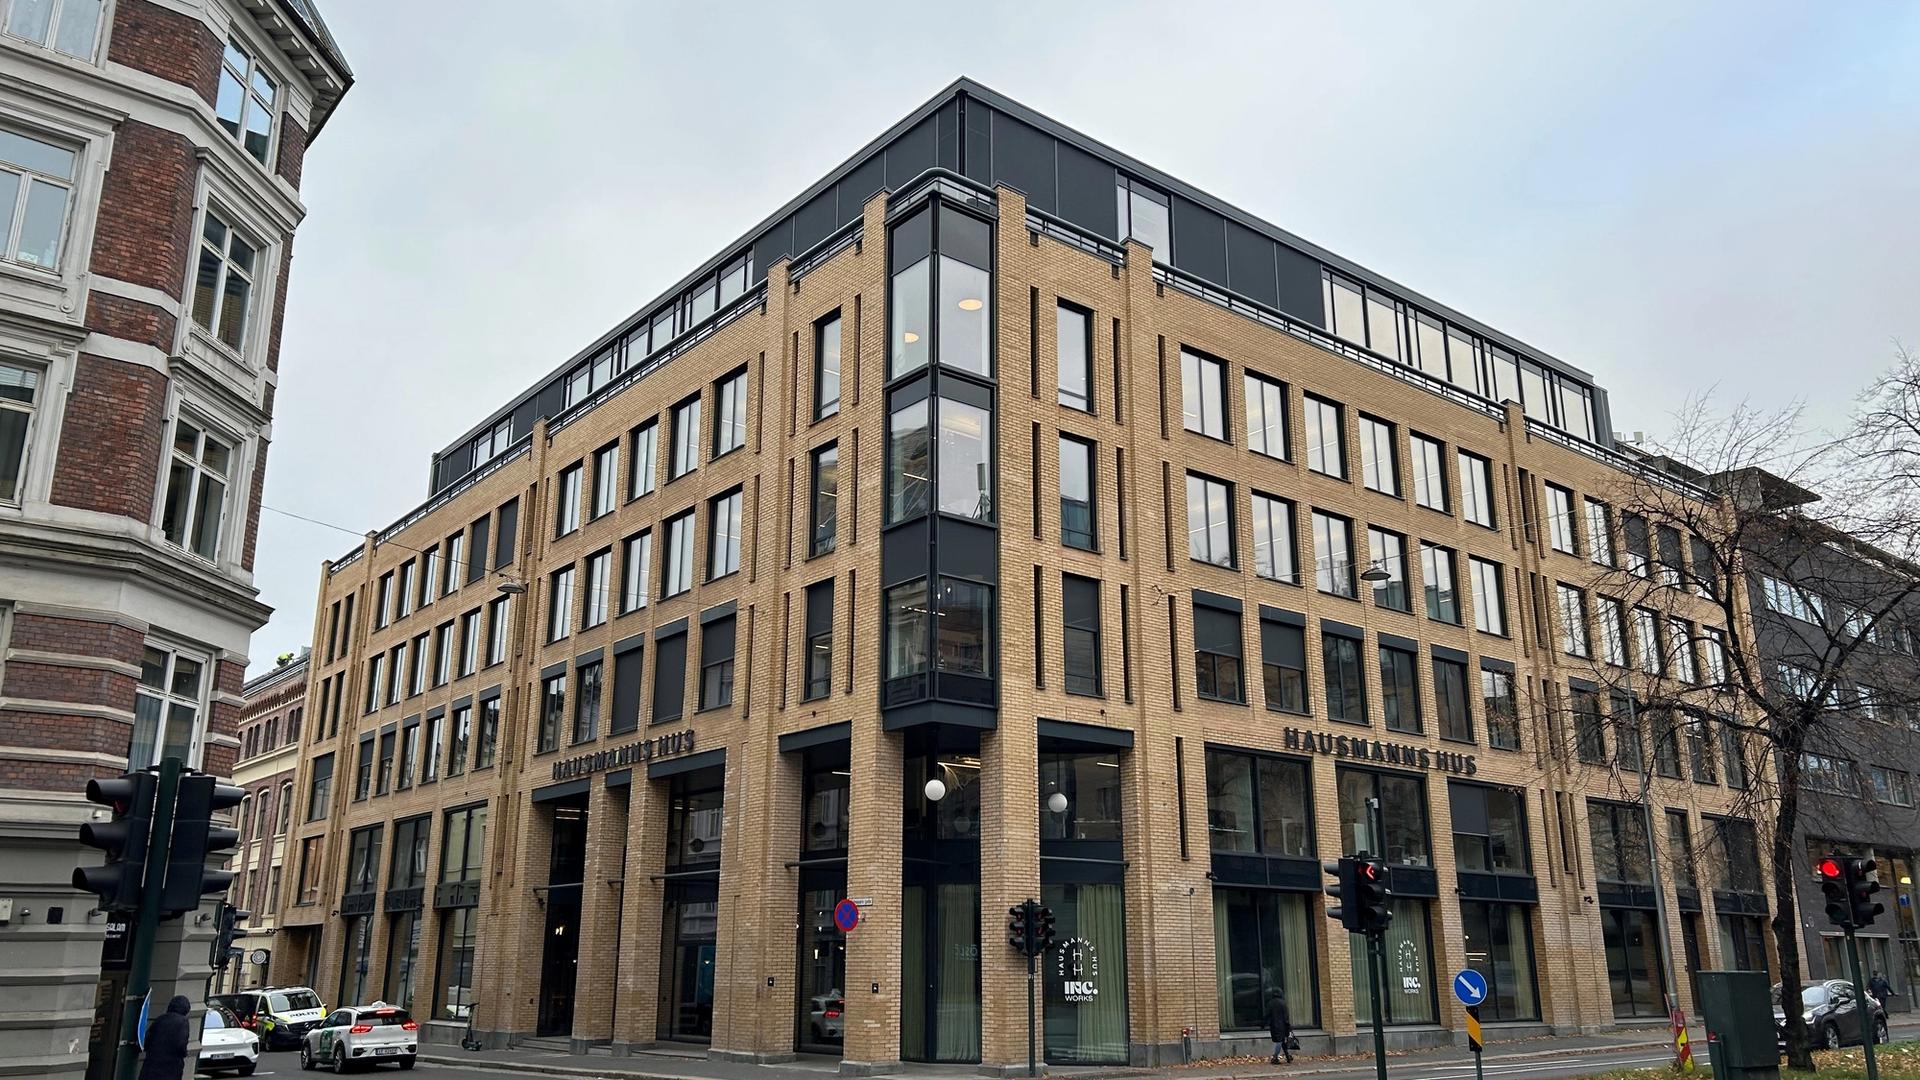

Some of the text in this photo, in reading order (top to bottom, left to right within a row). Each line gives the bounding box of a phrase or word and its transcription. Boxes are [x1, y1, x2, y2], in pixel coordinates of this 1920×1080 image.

[552, 729, 694, 780] HAUSMANNS HUS
[1284, 727, 1477, 774] HAUSMANNS HUS
[1058, 937, 1095, 976] HAUSMANNS
[1064, 981, 1099, 995] INC.
